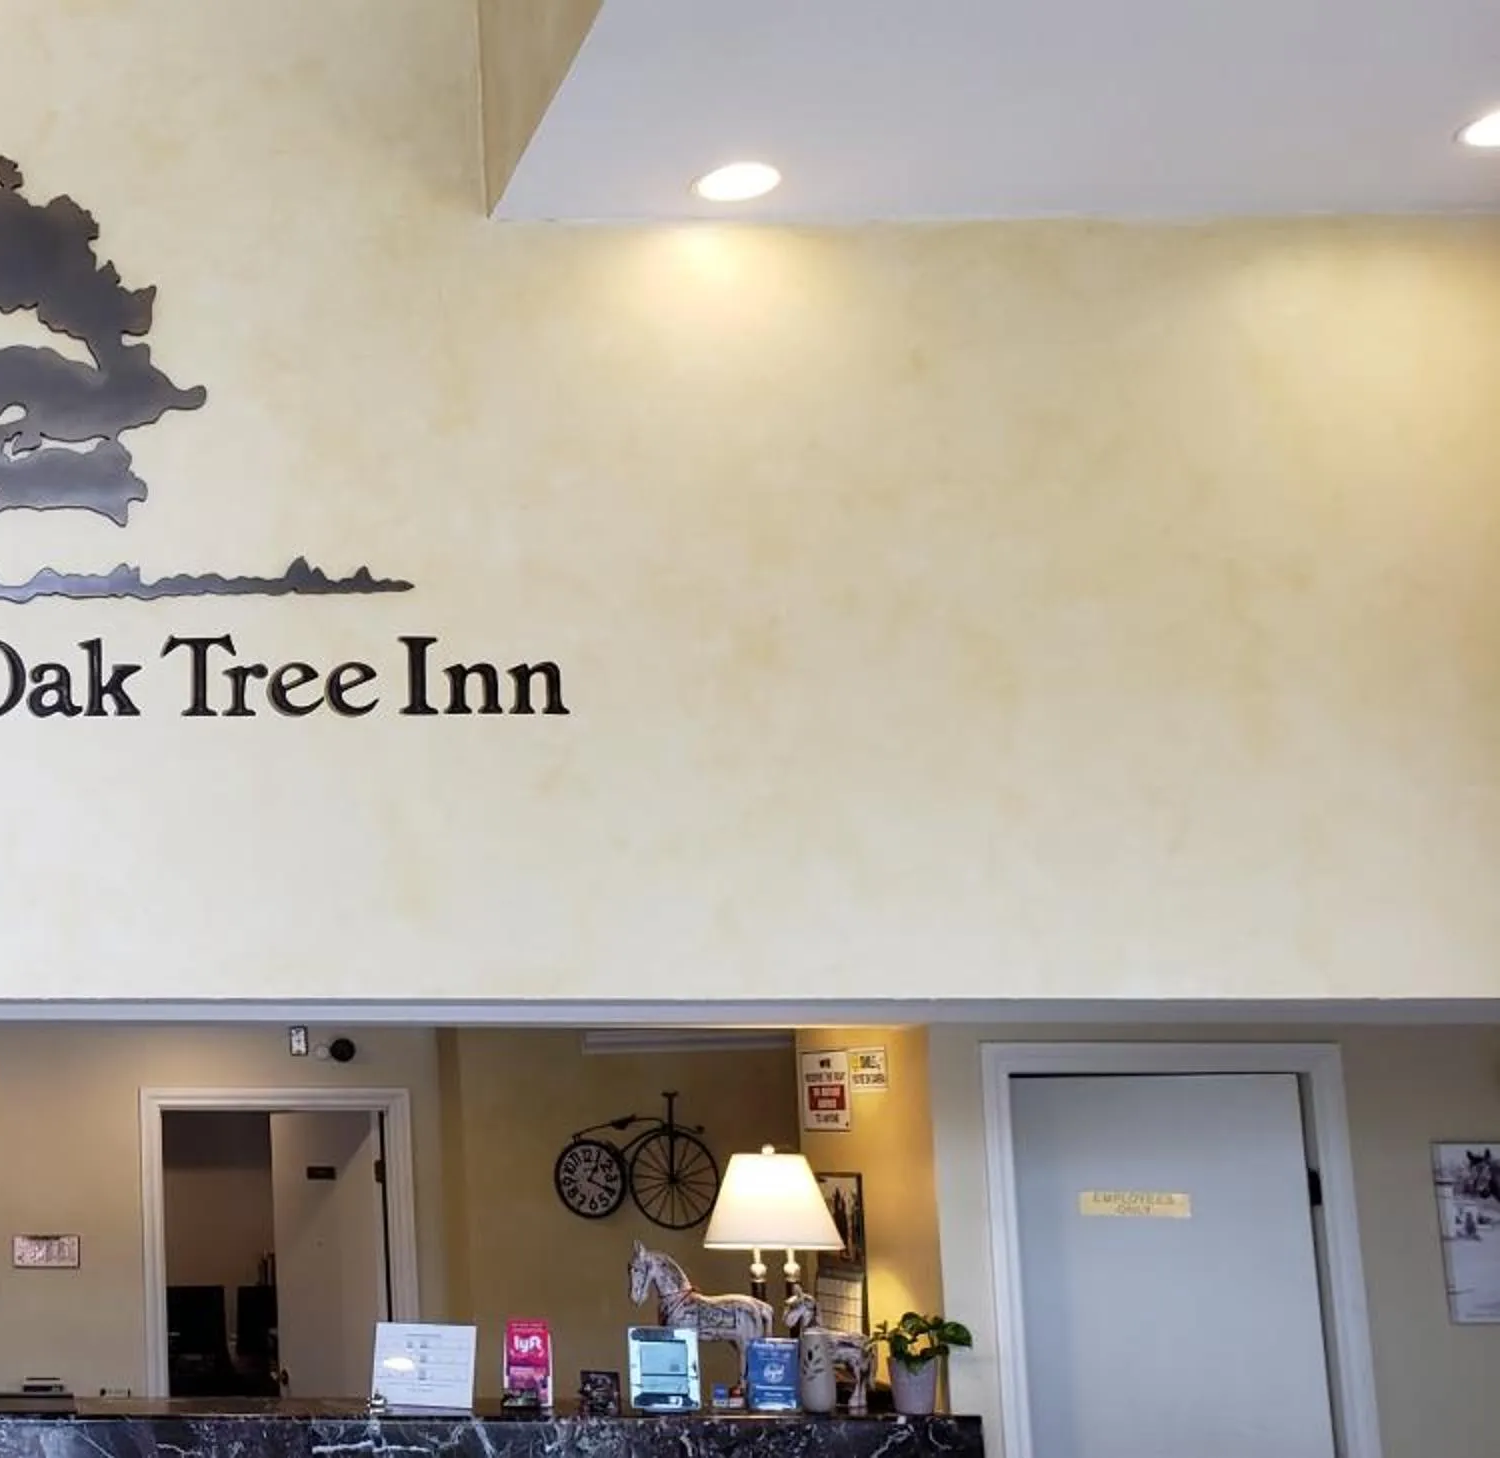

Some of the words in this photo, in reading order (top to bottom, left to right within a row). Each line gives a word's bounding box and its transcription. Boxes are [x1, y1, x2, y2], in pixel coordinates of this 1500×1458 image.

[161, 634, 380, 718] Tree
[398, 636, 571, 717] Inn
[513, 1335, 542, 1353] lyft
